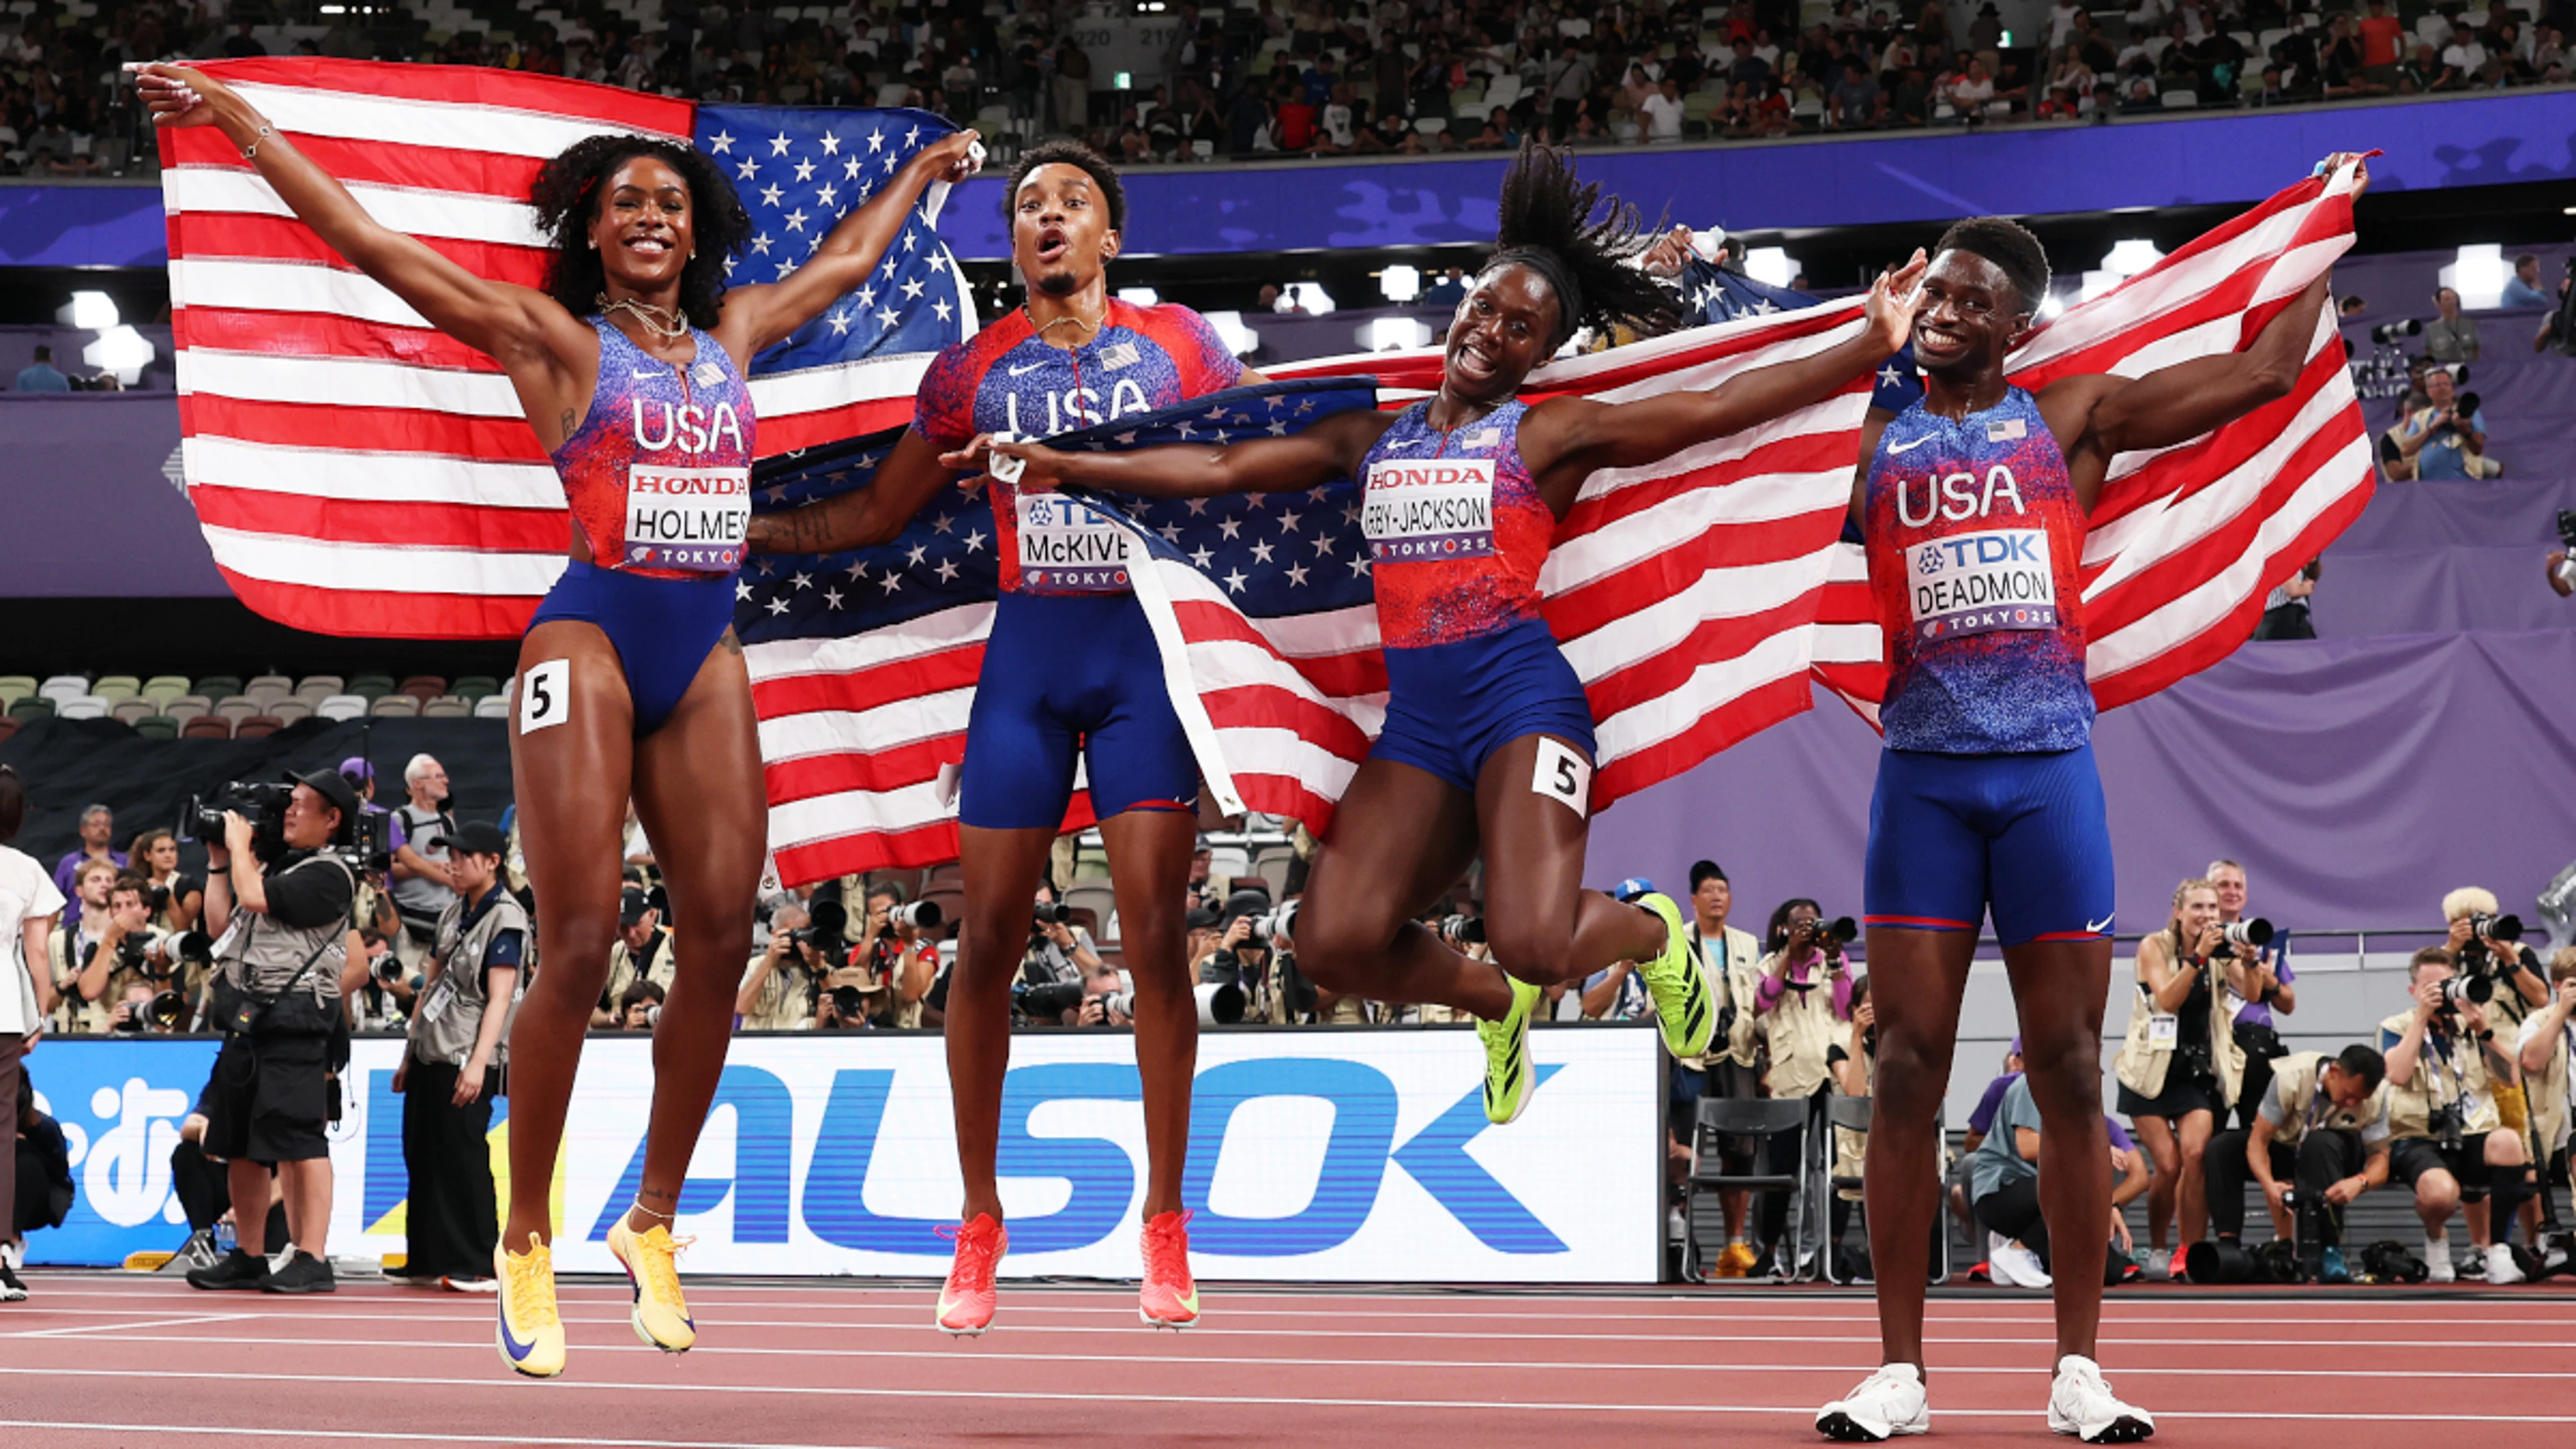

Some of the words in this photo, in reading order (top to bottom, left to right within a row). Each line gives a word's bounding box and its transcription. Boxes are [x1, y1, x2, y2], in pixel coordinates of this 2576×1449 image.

[633, 398, 744, 453] USA
[1007, 379, 1151, 436] USA
[633, 475, 748, 495] HONDA
[1368, 468, 1488, 490] HONDA
[1896, 464, 2025, 529] USA
[635, 508, 747, 540] HOLMES
[1943, 534, 2040, 568] TDK
[1917, 570, 2048, 615] DEADMON
[532, 673, 551, 720] 5
[1554, 755, 1576, 796] 5
[586, 1057, 1572, 1258] ALSOK
